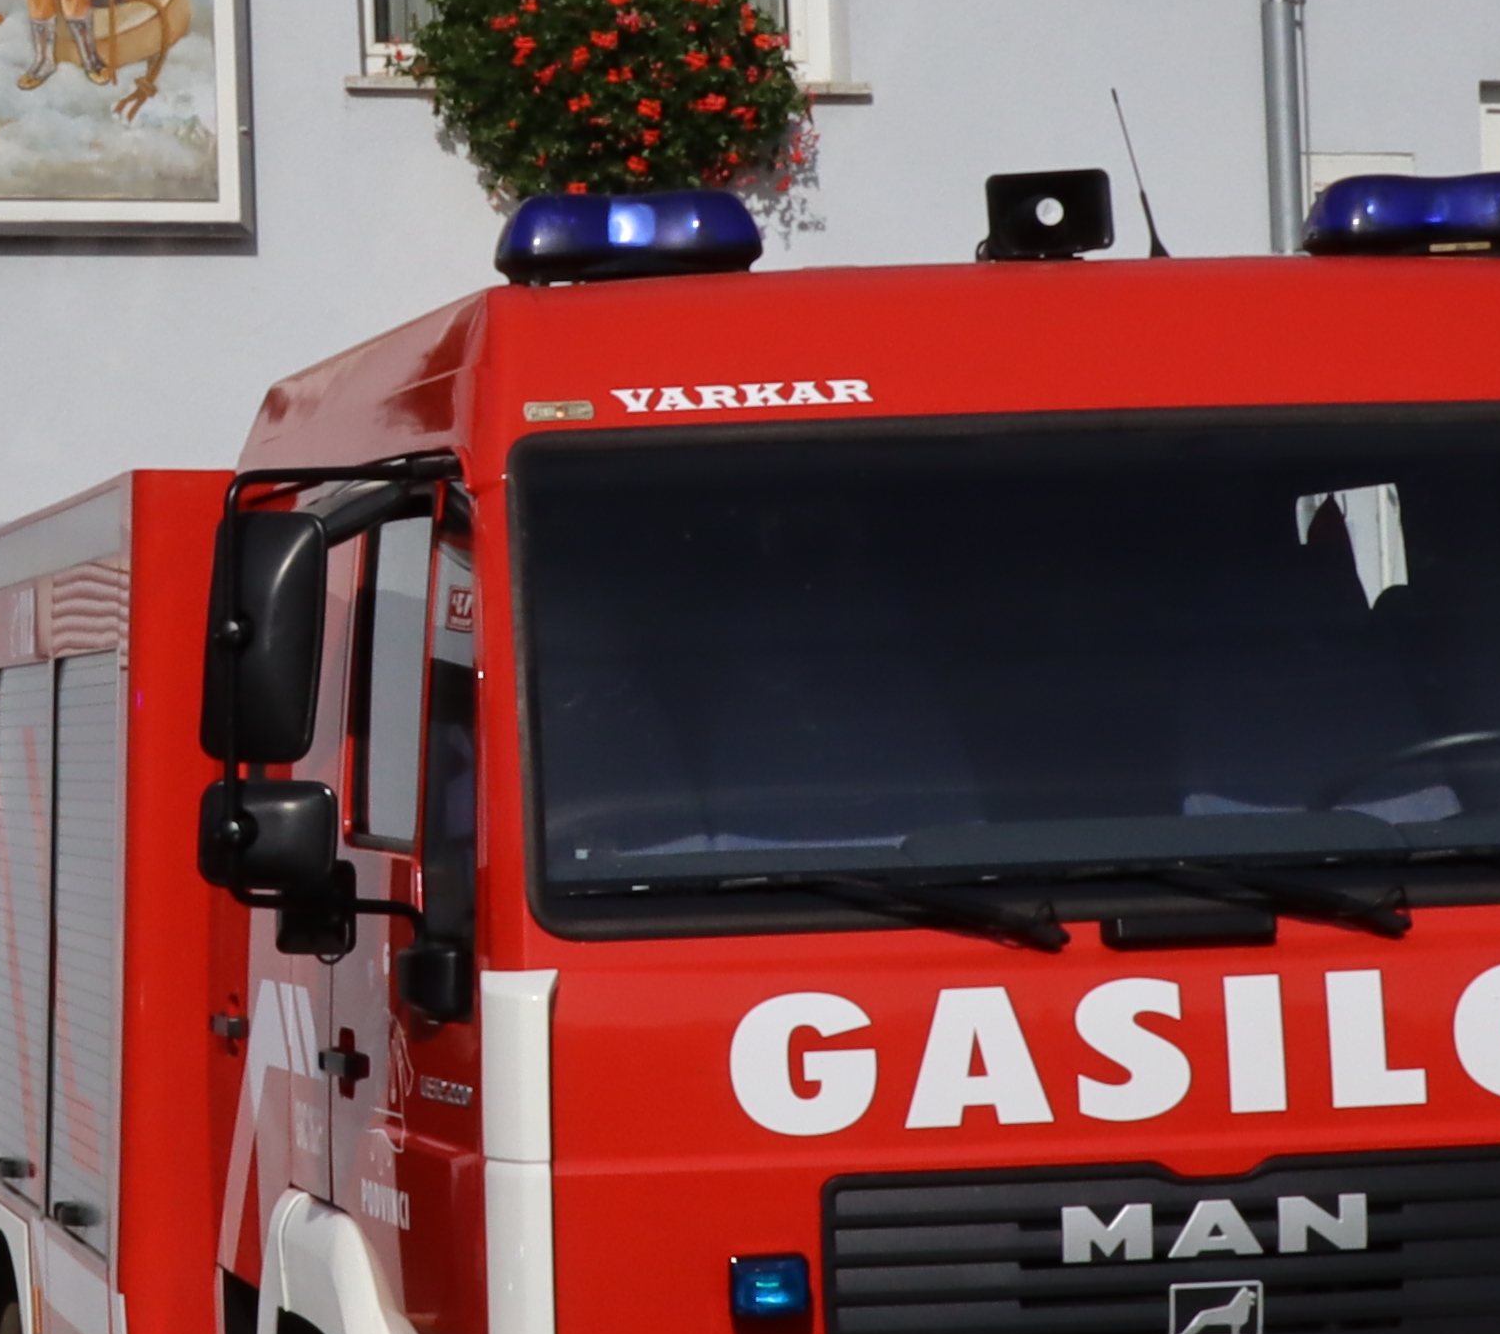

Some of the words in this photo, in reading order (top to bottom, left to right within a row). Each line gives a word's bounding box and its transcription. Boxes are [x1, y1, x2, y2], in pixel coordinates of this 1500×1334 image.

[610, 379, 874, 413] VARKAR
[361, 1177, 410, 1231] PODVINCI
[1061, 1193, 1367, 1263] MAN
